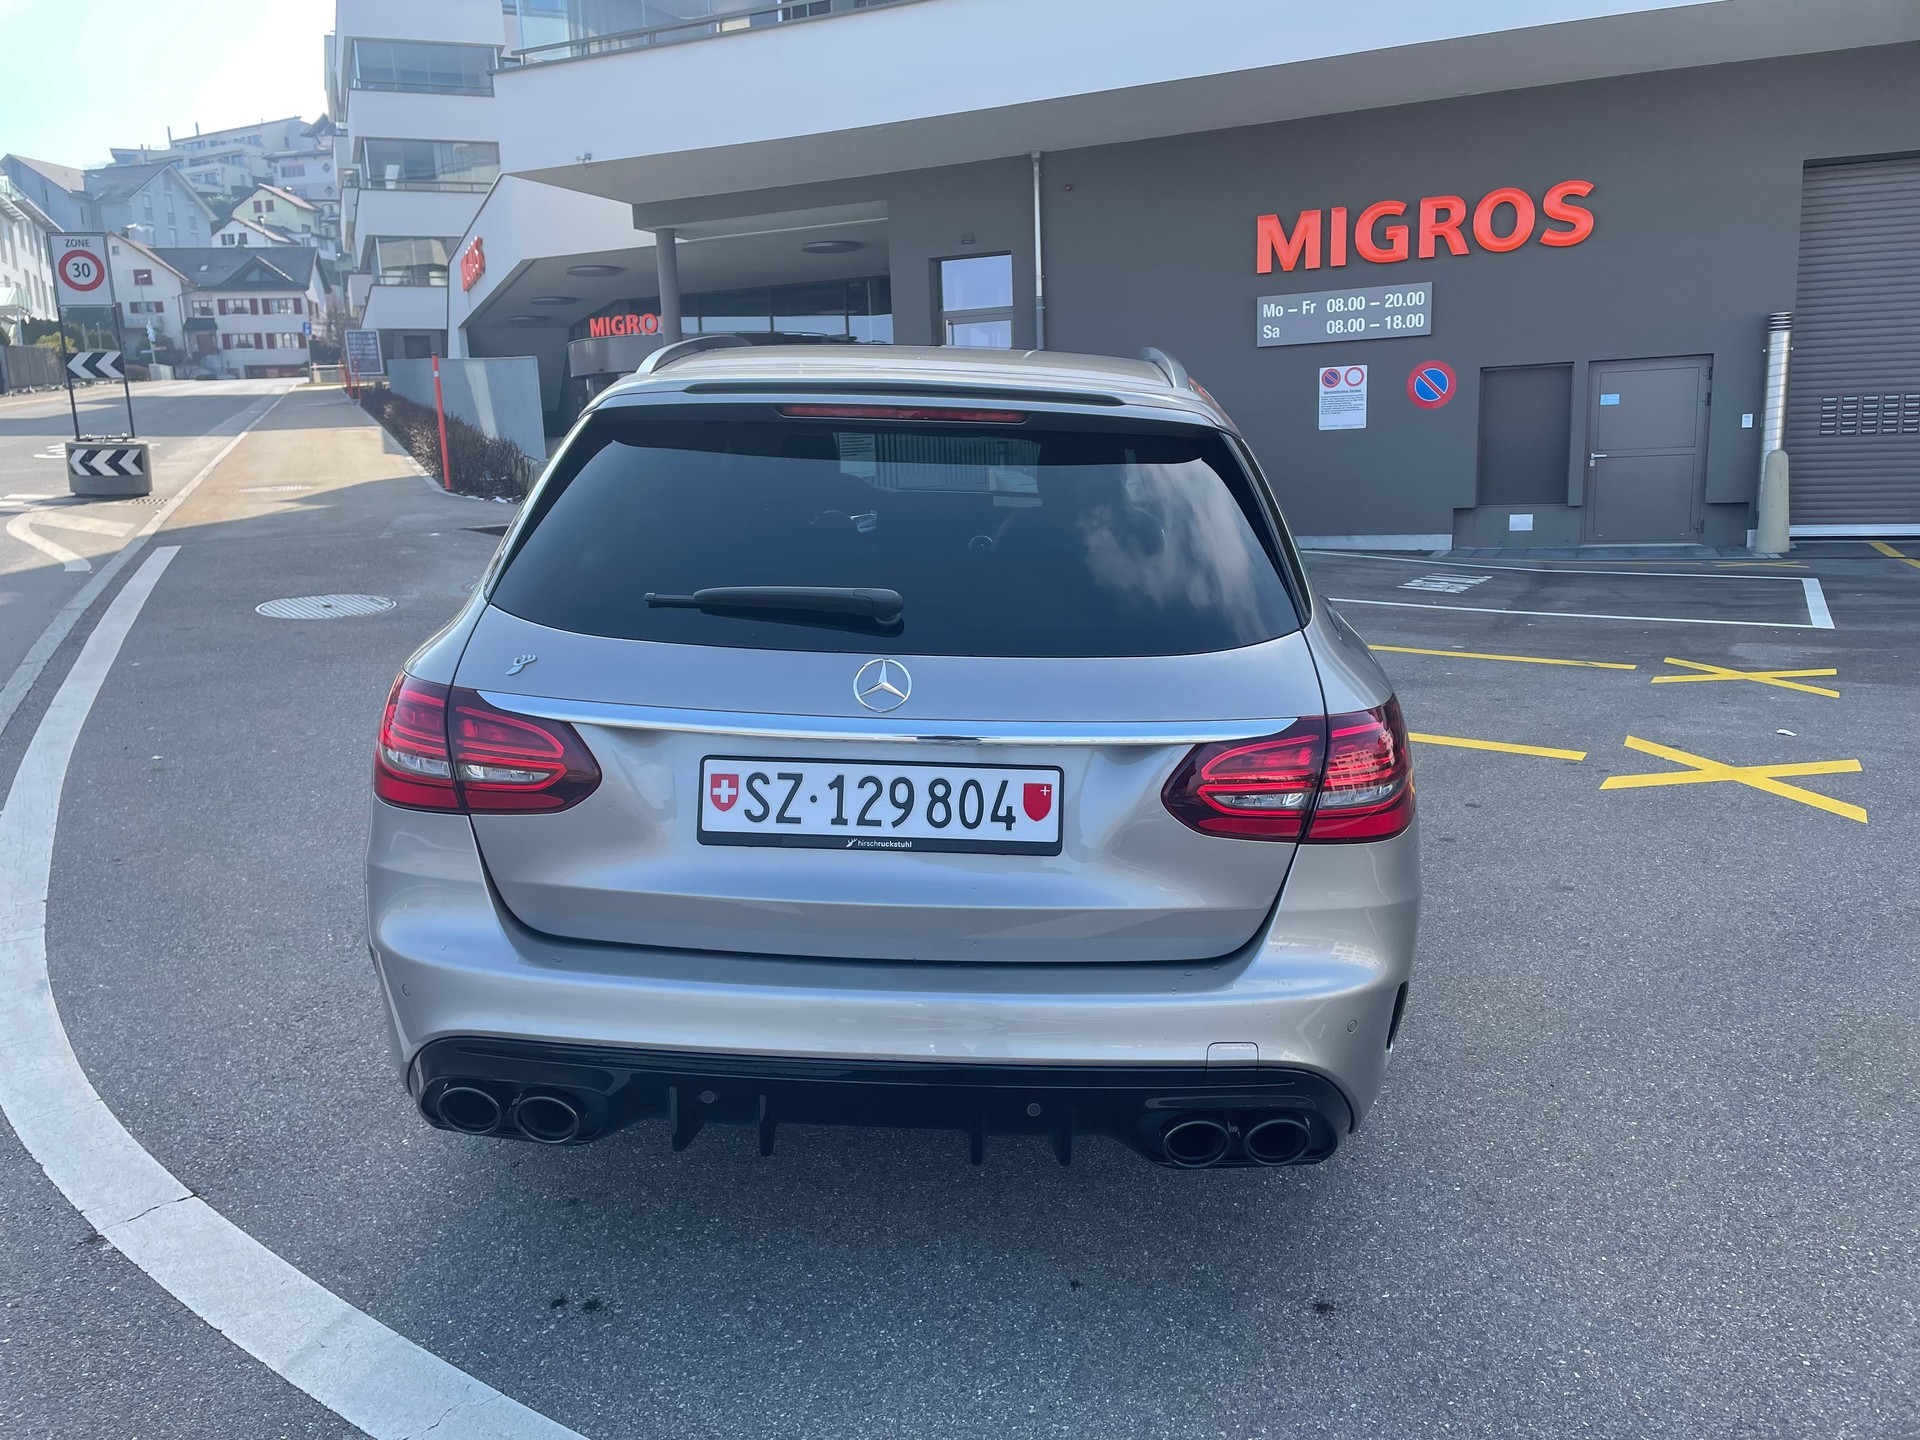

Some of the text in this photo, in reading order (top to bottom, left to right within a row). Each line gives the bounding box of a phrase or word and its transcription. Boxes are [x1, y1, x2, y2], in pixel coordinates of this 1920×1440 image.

[1256, 180, 1595, 274] MIGROS
[64, 238, 91, 248] ZONE
[72, 262, 91, 278] 30
[1263, 303, 1284, 318] Mo
[1302, 300, 1317, 315] Fr
[1326, 296, 1366, 313] 08.00
[1384, 291, 1425, 308] 20.00
[1263, 324, 1280, 339] Sa
[1326, 317, 1366, 335] 08.00
[1384, 312, 1425, 330] 18.00
